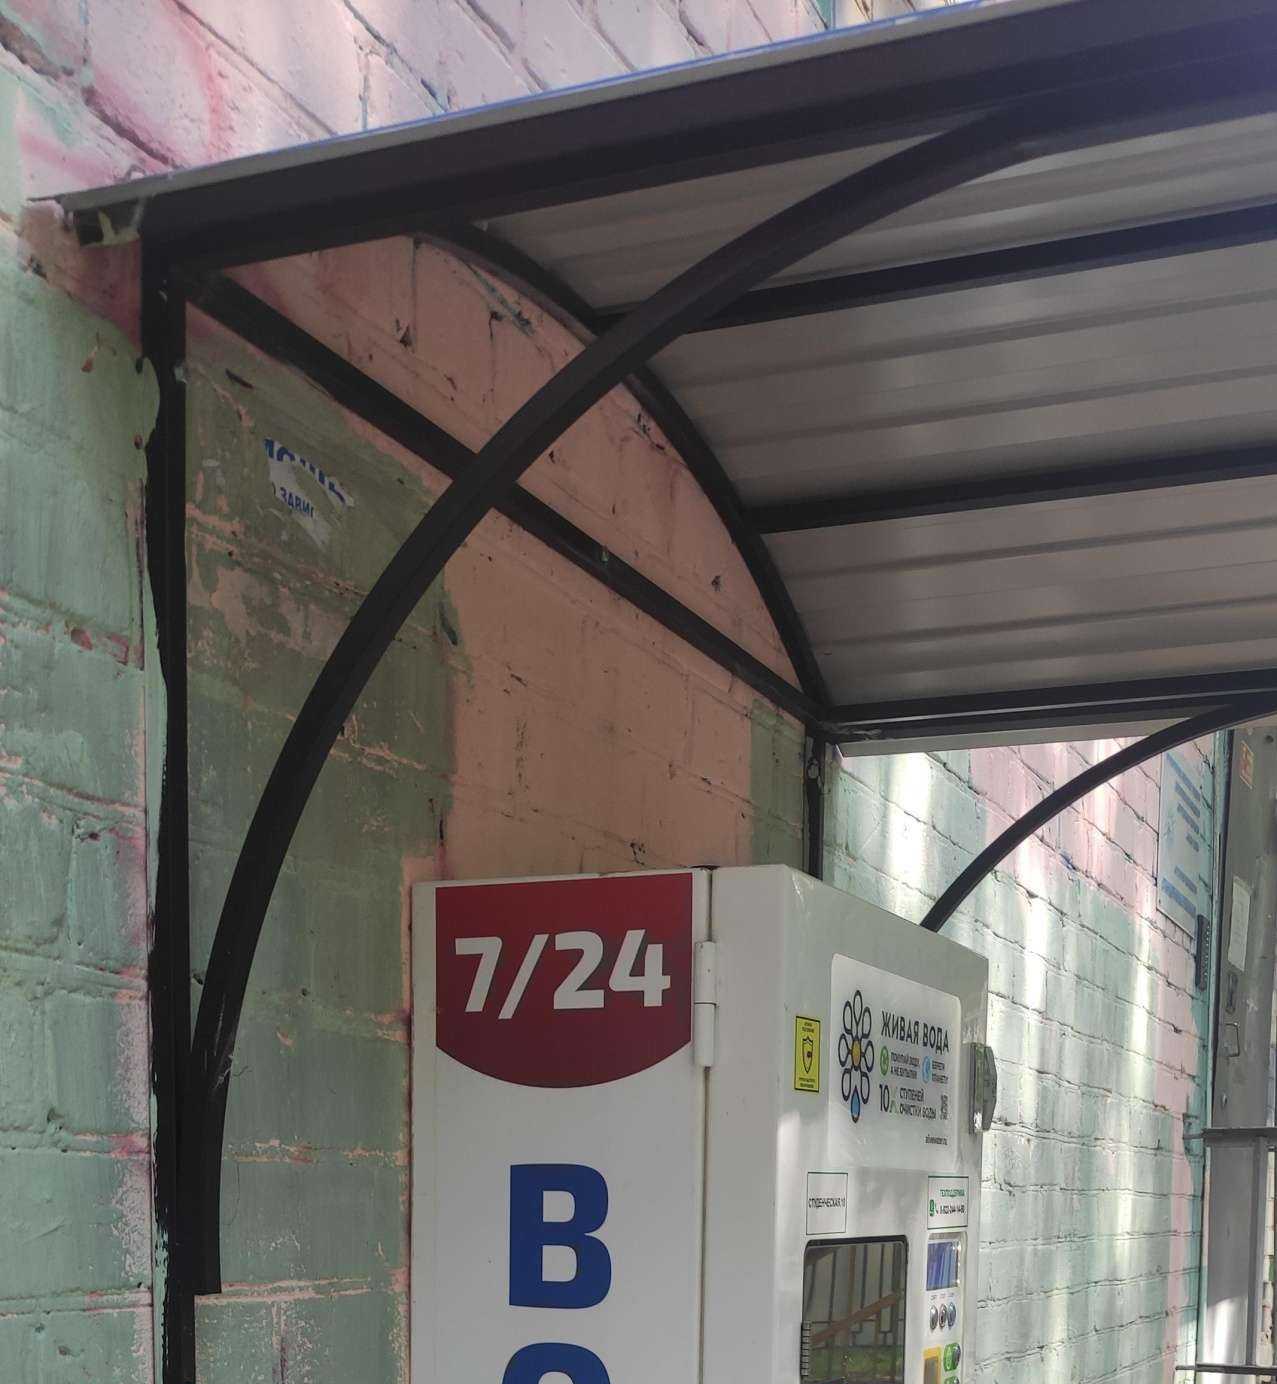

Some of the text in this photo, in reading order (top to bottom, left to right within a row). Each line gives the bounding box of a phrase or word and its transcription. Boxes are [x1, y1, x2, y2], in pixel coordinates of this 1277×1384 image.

[455, 929, 671, 1020] 7/24
[880, 1011, 950, 1054] ЖИВАЯ ВОДА
[879, 1084, 889, 1112] 10
